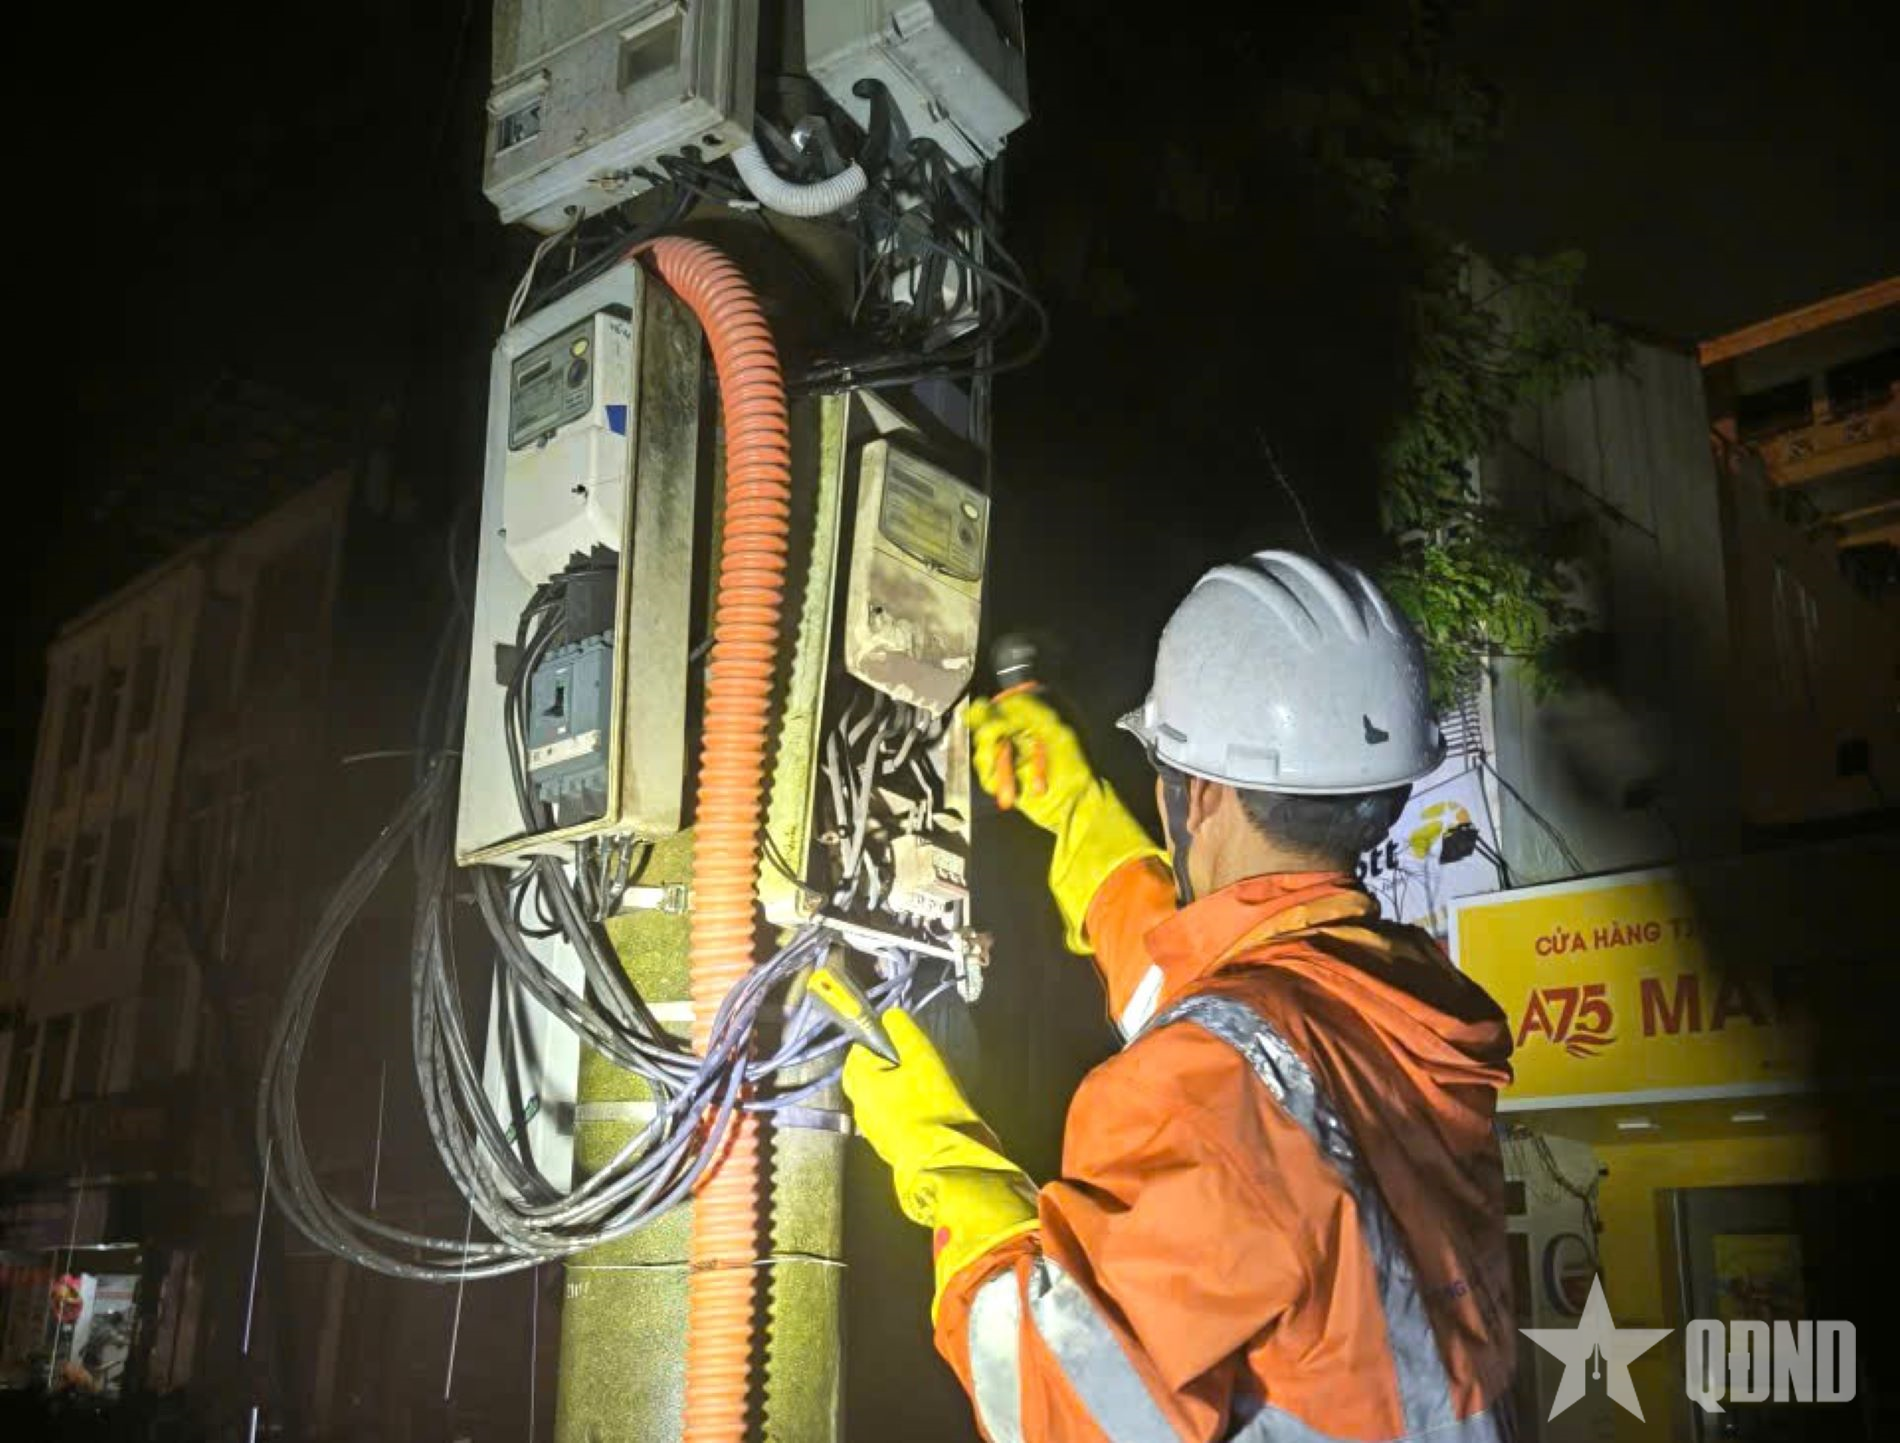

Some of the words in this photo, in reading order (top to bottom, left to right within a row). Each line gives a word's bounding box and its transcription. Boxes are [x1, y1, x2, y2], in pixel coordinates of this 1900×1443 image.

[1535, 926, 1586, 956] CỬA
[1594, 921, 1661, 949] HÀNG
[1516, 983, 1613, 1047] A75
